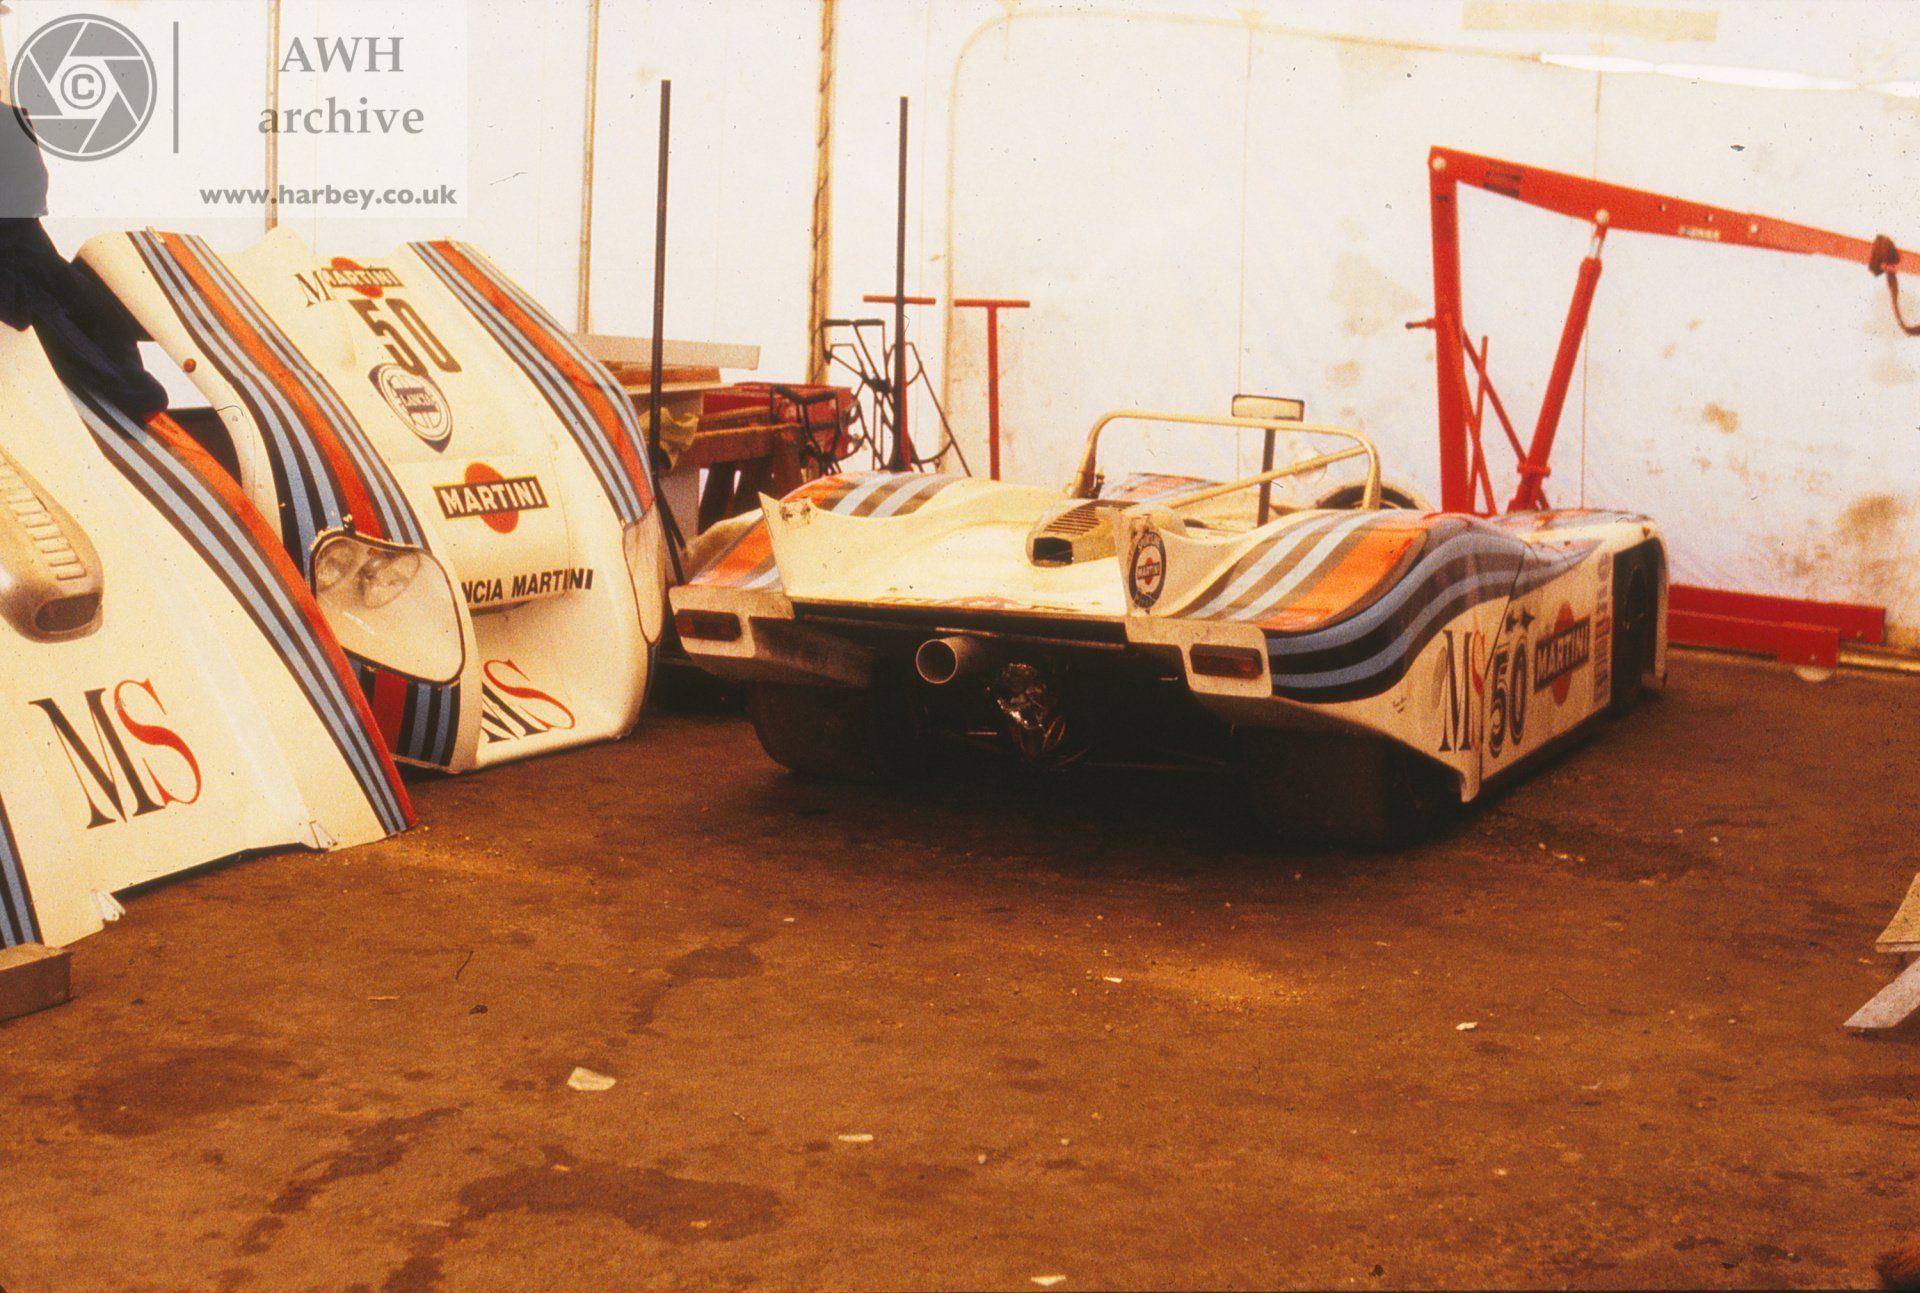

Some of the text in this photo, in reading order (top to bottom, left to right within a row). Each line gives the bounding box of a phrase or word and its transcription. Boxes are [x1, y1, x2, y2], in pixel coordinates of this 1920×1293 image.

[347, 298, 462, 377] 50
[439, 480, 544, 516] MARTINI
[461, 568, 593, 603] NCIA MARTINI
[1489, 636, 1527, 758] 50
[29, 678, 201, 829] MS
